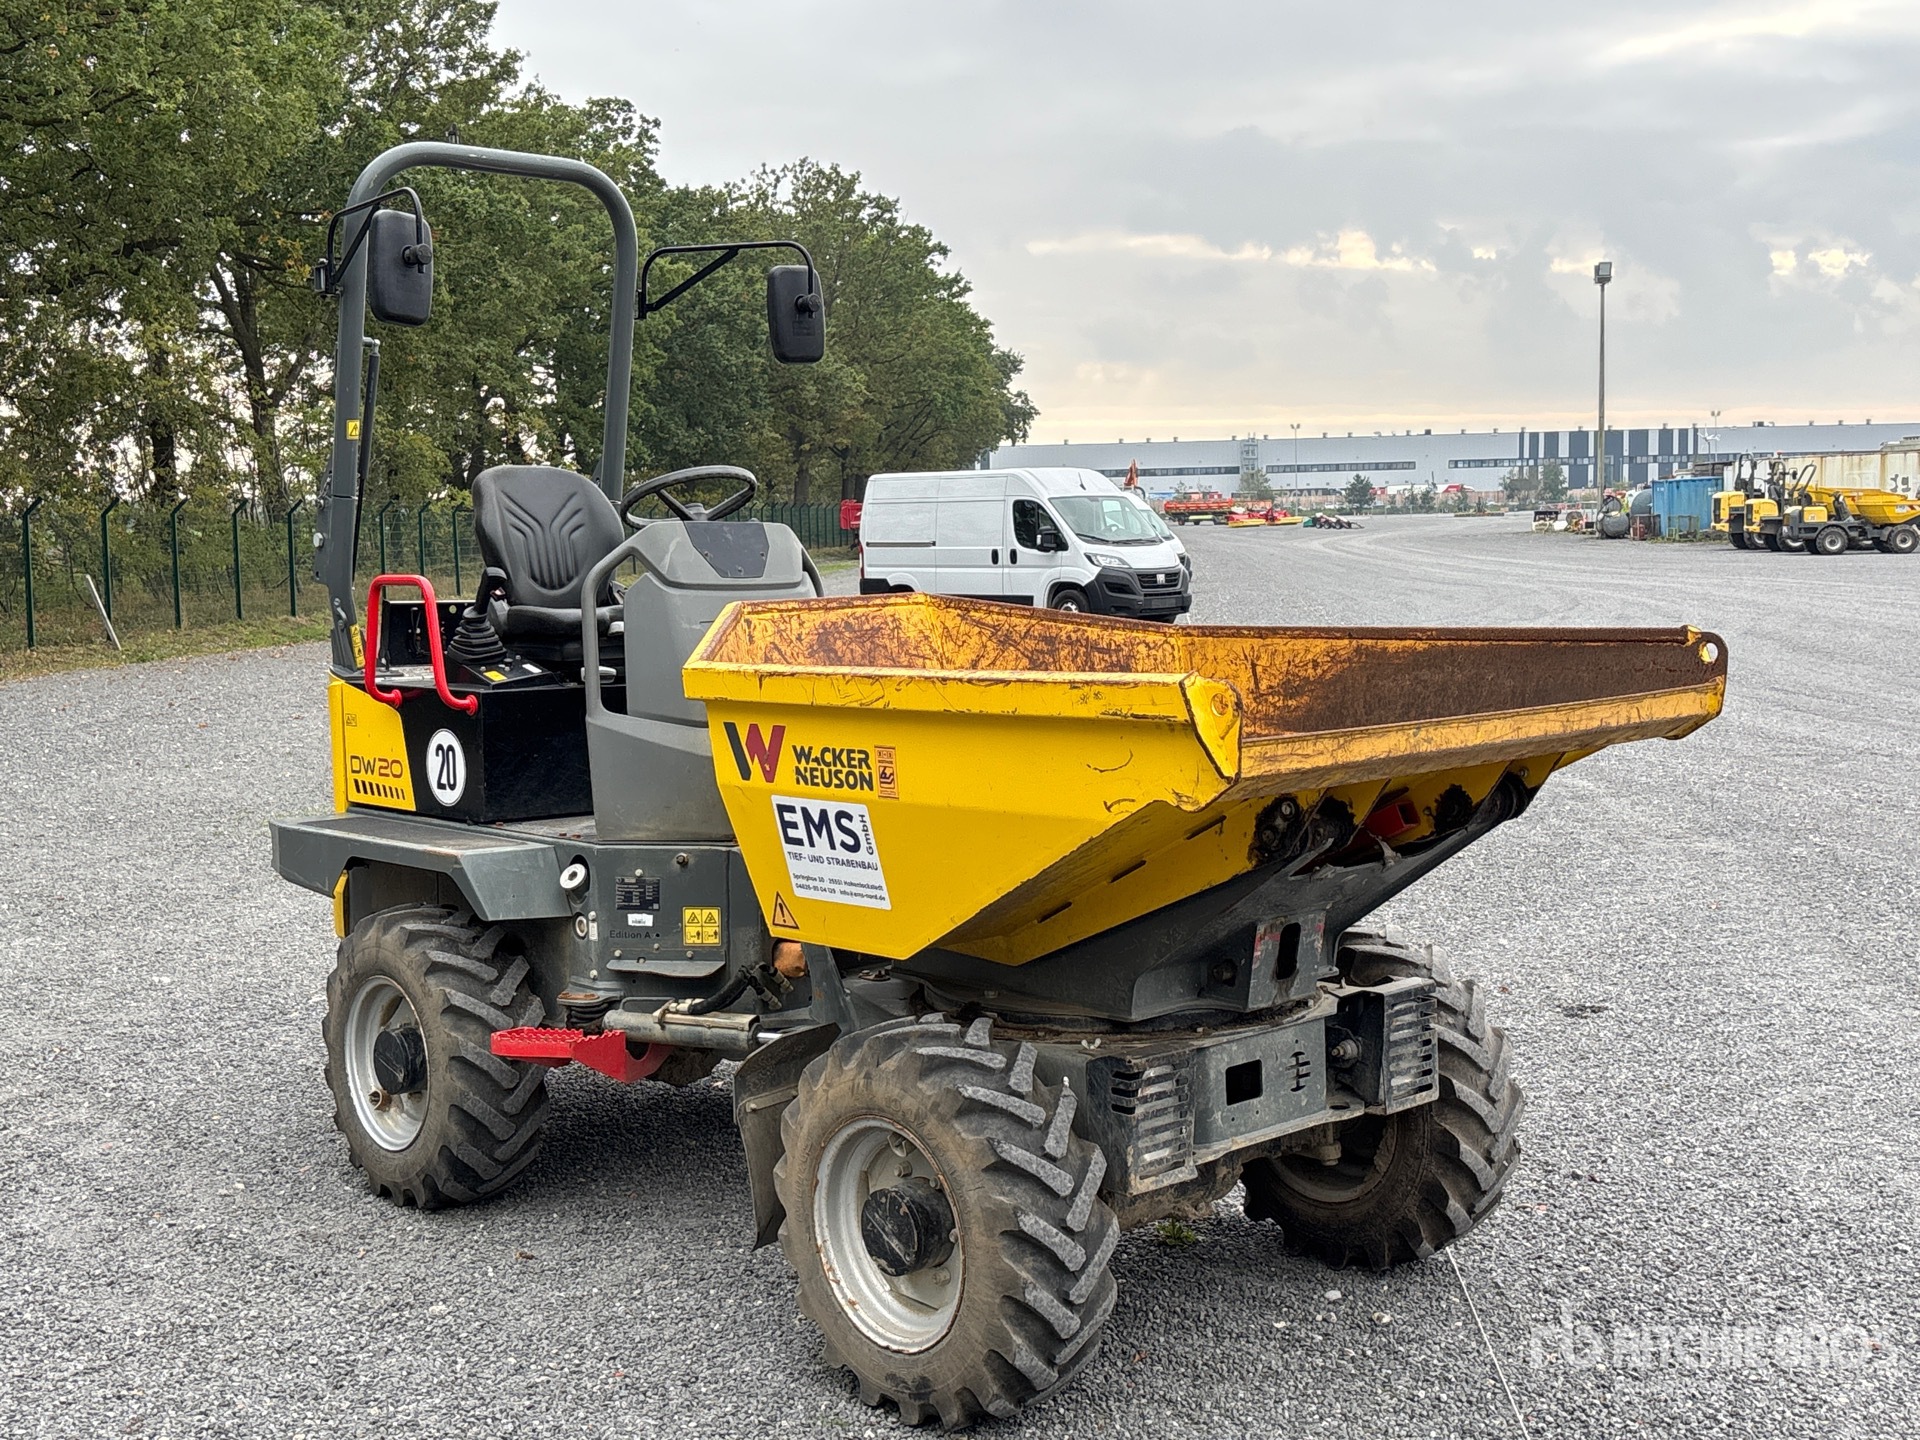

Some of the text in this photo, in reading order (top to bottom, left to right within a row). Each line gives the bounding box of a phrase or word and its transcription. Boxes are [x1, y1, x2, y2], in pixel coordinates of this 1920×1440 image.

[350, 755, 403, 778] DW20
[435, 743, 457, 791] 20
[792, 745, 872, 770] WACKER
[795, 766, 874, 791] NEUSON
[776, 803, 861, 853] EMS
[858, 814, 874, 855] GmbH
[787, 851, 806, 861] TIEF-
[808, 854, 824, 864] UND
[609, 930, 651, 939] Edition A
